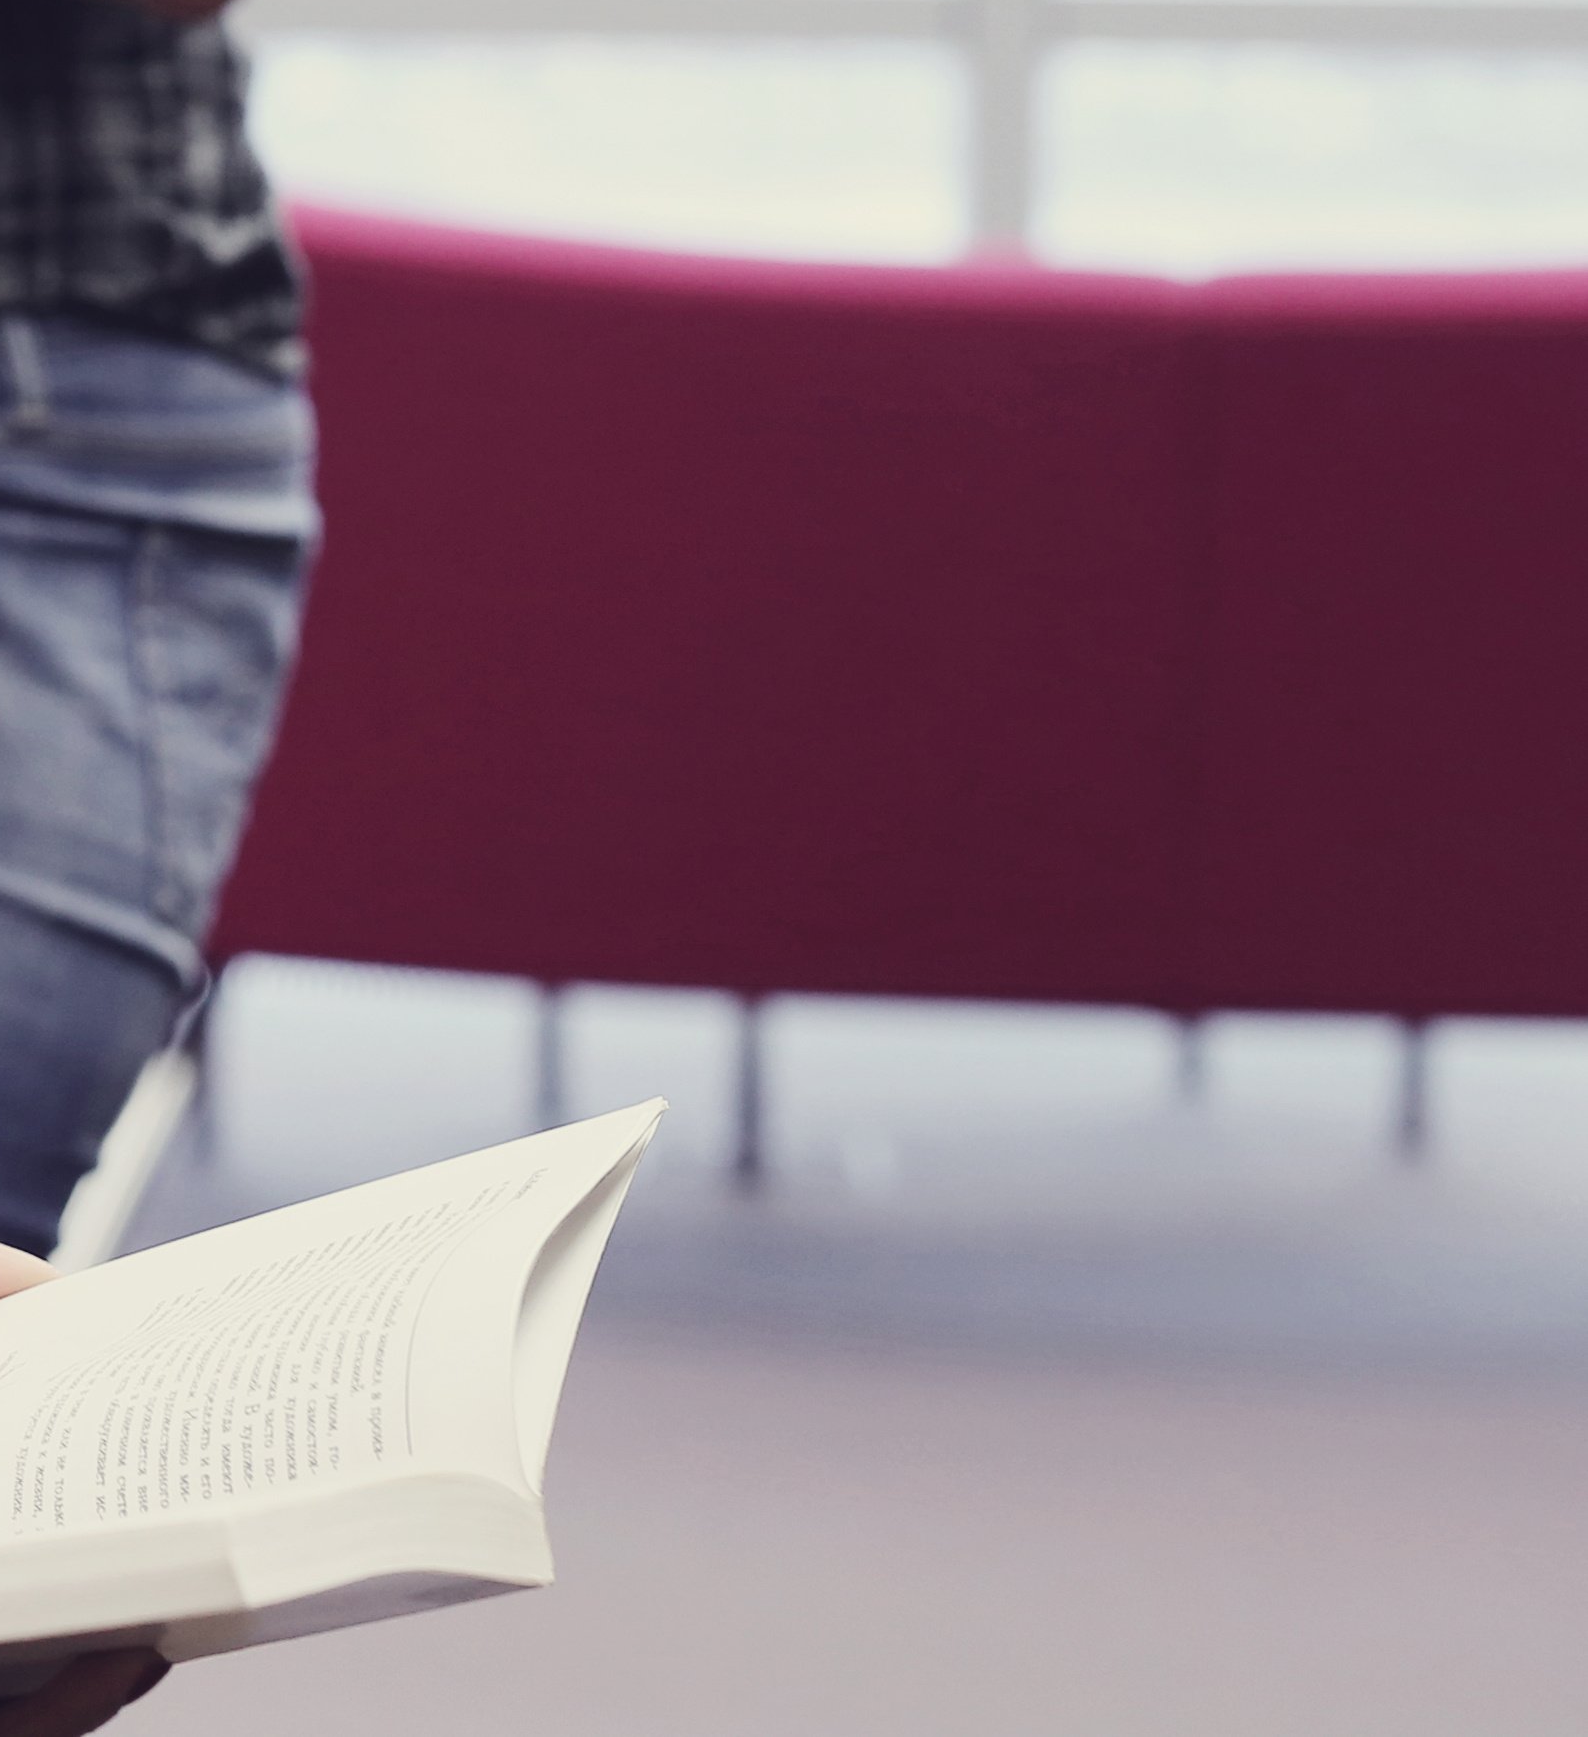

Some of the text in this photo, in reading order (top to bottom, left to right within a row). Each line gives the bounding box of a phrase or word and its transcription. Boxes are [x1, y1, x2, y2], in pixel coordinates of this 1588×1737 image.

[118, 1406, 135, 1466] конечном
[179, 1408, 198, 1466] Именно
[200, 1378, 220, 1500] определять и его
[221, 1396, 235, 1433] тогда
[264, 1408, 274, 1448] часто
[284, 1363, 301, 1481] для художника
[306, 1399, 319, 1475] самостоя-
[325, 1393, 338, 1437] умом,
[56, 1455, 66, 1471] не
[96, 1399, 121, 1486] обнаруживает
[137, 1396, 156, 1513] проявляется вне
[158, 1390, 178, 1509] художественного
[221, 1443, 233, 1494] имеют
[240, 1404, 261, 1489] В художе-
[328, 1446, 339, 1470] го-
[12, 1446, 29, 1520] художник,
[32, 1466, 46, 1518] жизни,
[117, 1476, 128, 1517] счете
[264, 1458, 274, 1484] по-
[96, 1495, 106, 1520] ис-
